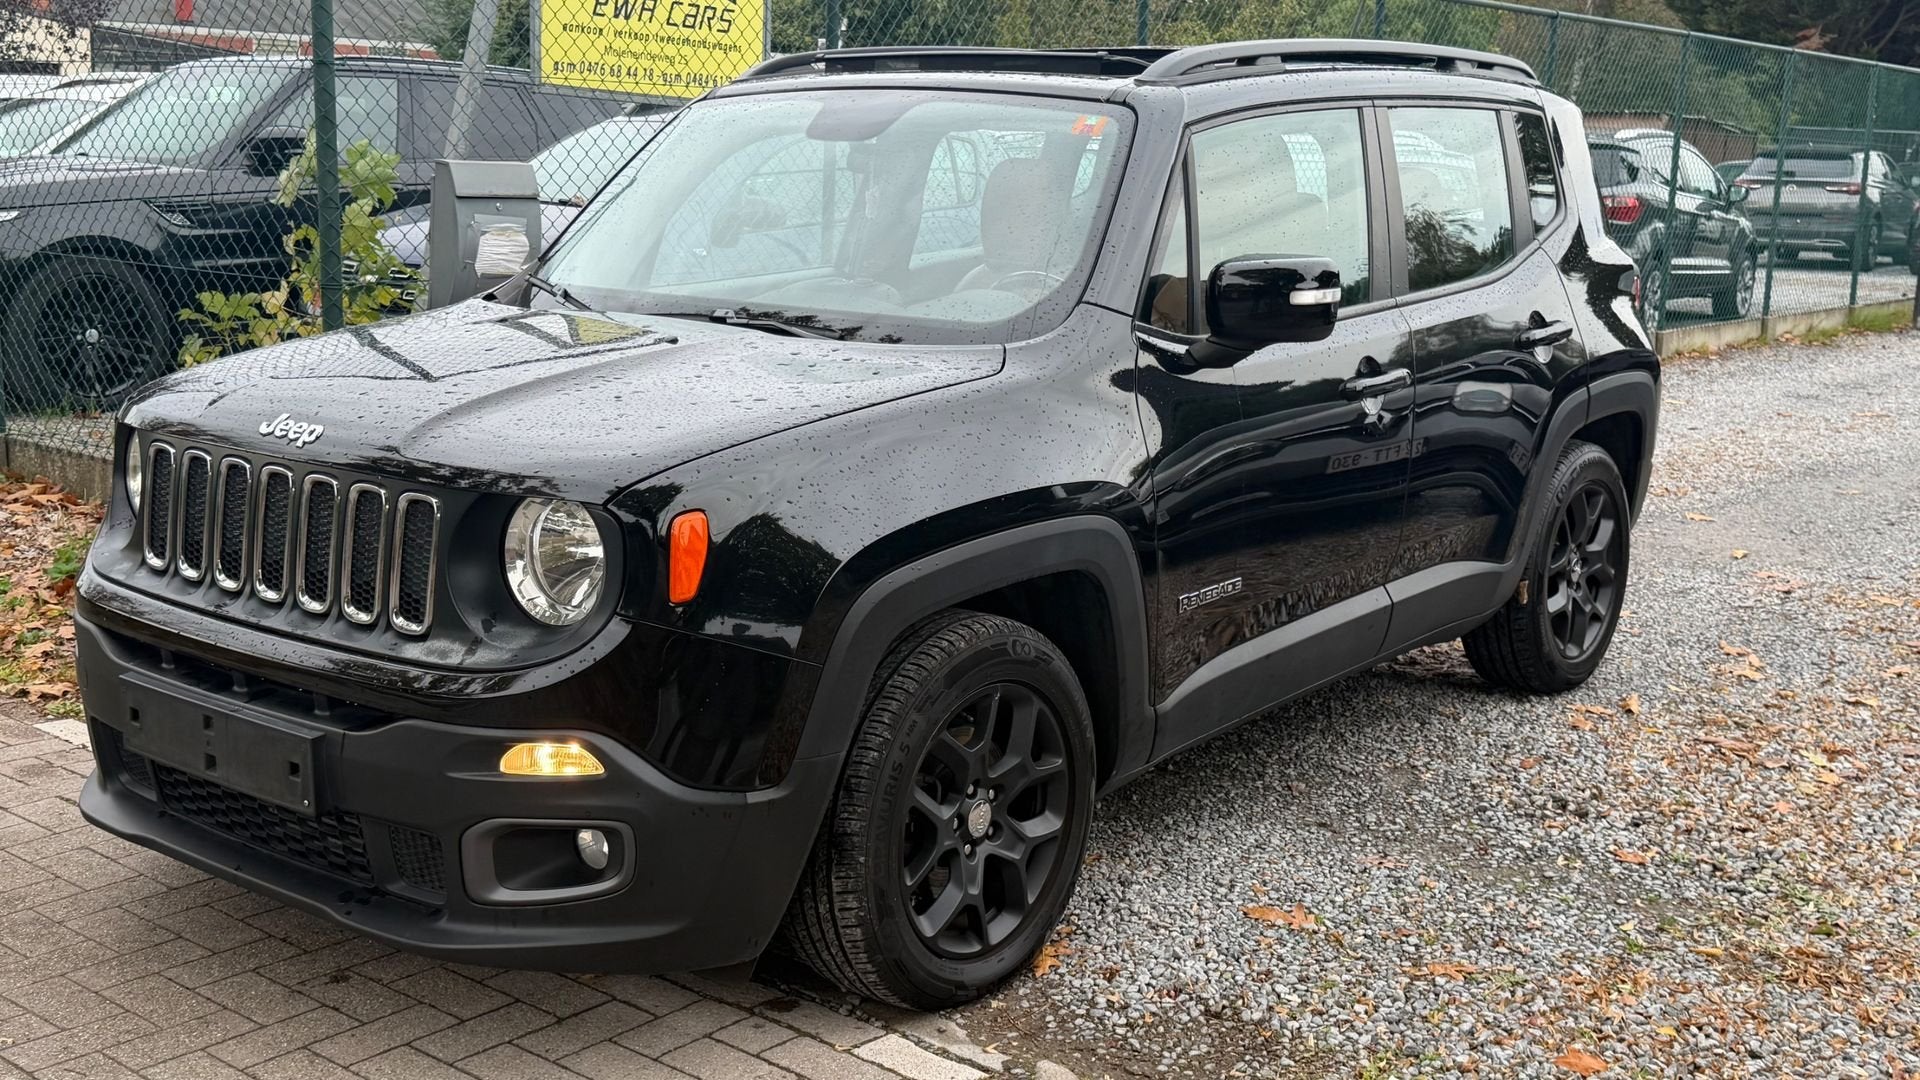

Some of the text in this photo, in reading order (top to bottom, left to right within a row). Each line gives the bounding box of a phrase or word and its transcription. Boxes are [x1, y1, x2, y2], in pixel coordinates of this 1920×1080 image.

[562, 22, 603, 38] aankoop
[613, 27, 650, 44] verkoop
[655, 32, 742, 54] tweedehandswagens
[553, 61, 576, 75] gsm
[580, 60, 606, 76] 0476
[610, 64, 622, 78] 68
[626, 65, 638, 79] 44
[686, 72, 709, 87] 0484
[259, 413, 324, 448] Jeep
[1179, 577, 1242, 613] RENEGADE
[900, 741, 911, 756] 5
